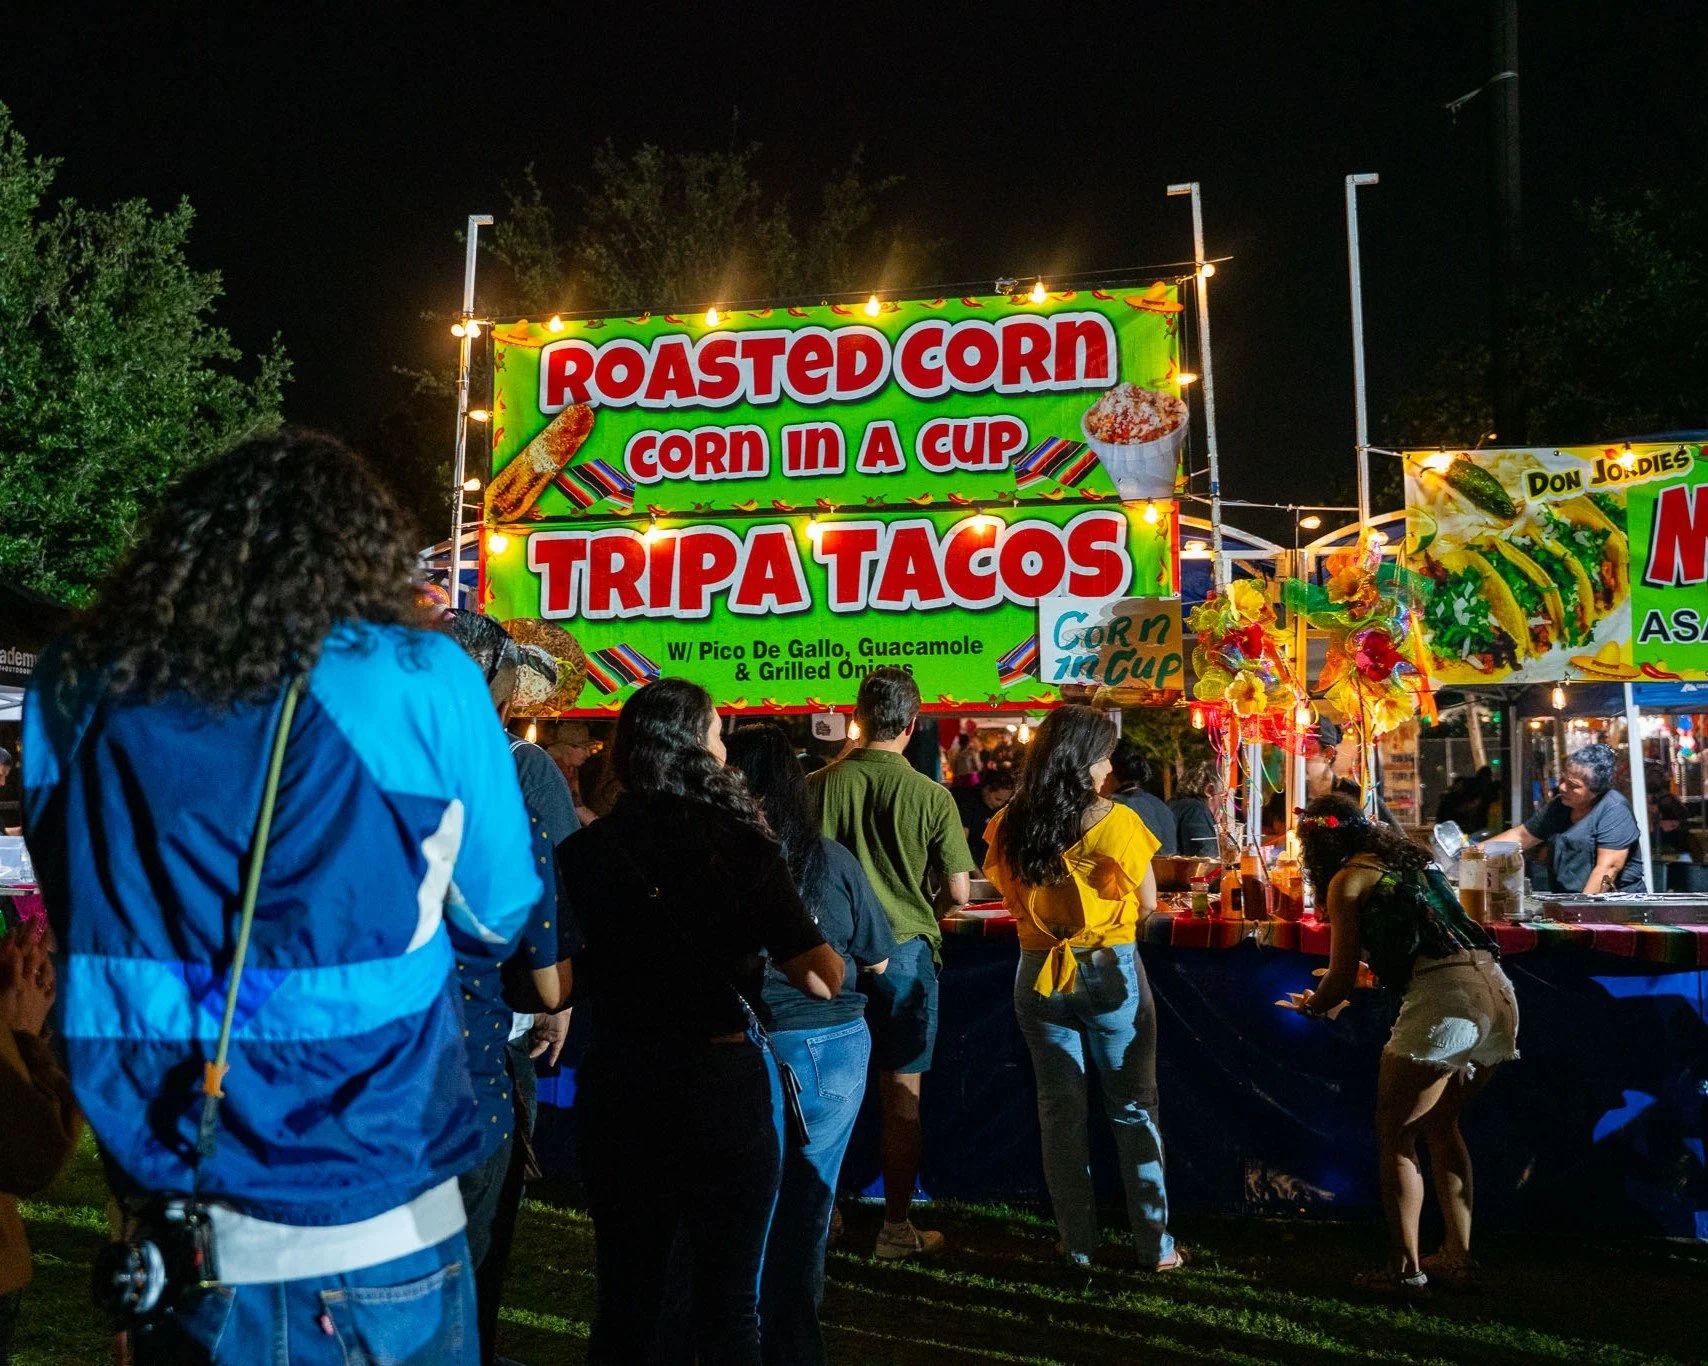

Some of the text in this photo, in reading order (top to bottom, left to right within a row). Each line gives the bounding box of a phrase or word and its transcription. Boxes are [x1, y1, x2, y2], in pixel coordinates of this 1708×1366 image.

[861, 425, 900, 469] A
[921, 419, 1022, 466] CUP
[1526, 469, 1582, 500] DON
[535, 518, 1126, 610] TRIPA TACOS
[0, 646, 38, 667] adem
[667, 635, 984, 663] W/ Pico De Gallo, Guacamole
[734, 659, 914, 681] & Grilled Onis
[1103, 648, 1183, 689] Cup
